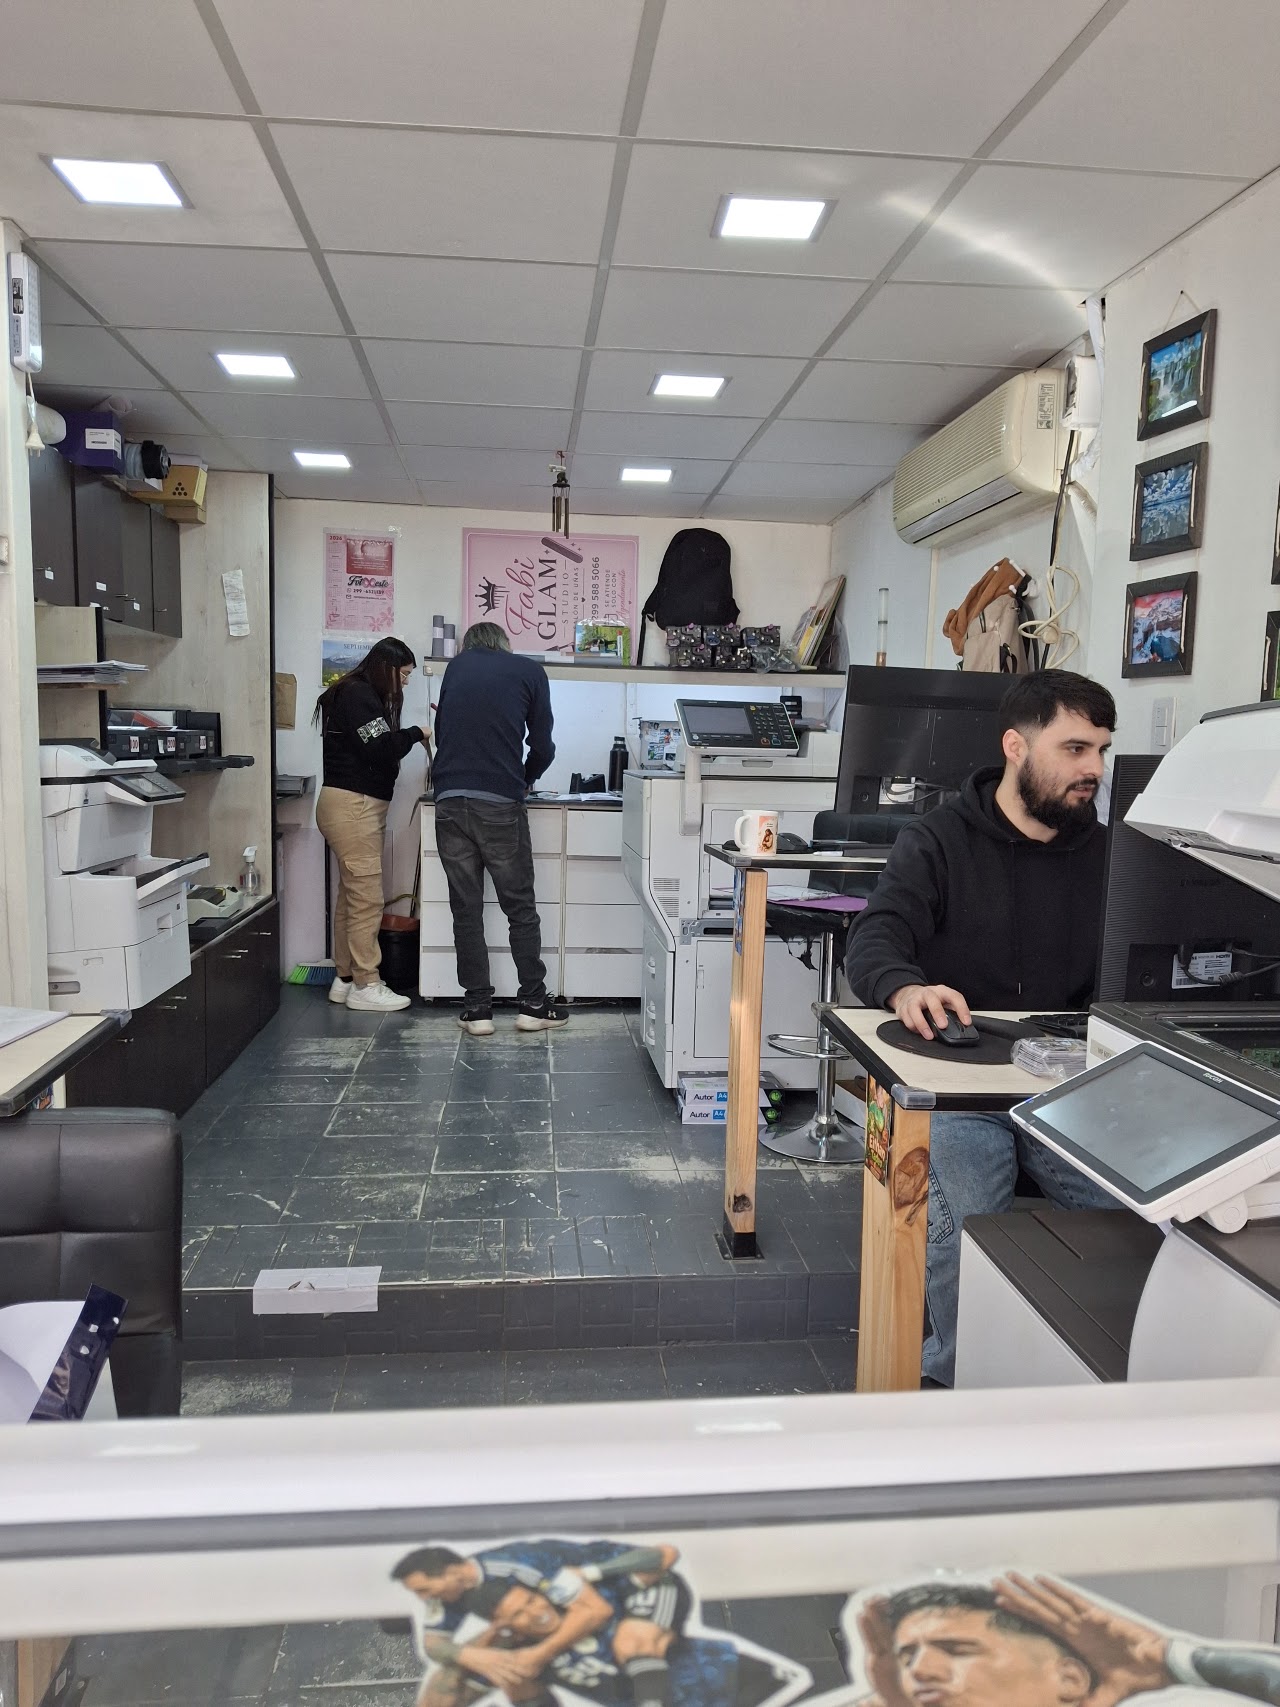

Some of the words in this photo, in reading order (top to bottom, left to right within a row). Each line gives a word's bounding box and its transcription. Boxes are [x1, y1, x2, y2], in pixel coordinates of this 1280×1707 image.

[591, 556, 600, 581] 5066
[505, 557, 538, 635] Fabi
[537, 558, 557, 641] GLAM
[573, 591, 579, 601] DE
[591, 583, 600, 601] 588
[591, 603, 599, 621] 299
[605, 600, 610, 608] SE
[693, 1093, 715, 1101] Autor
